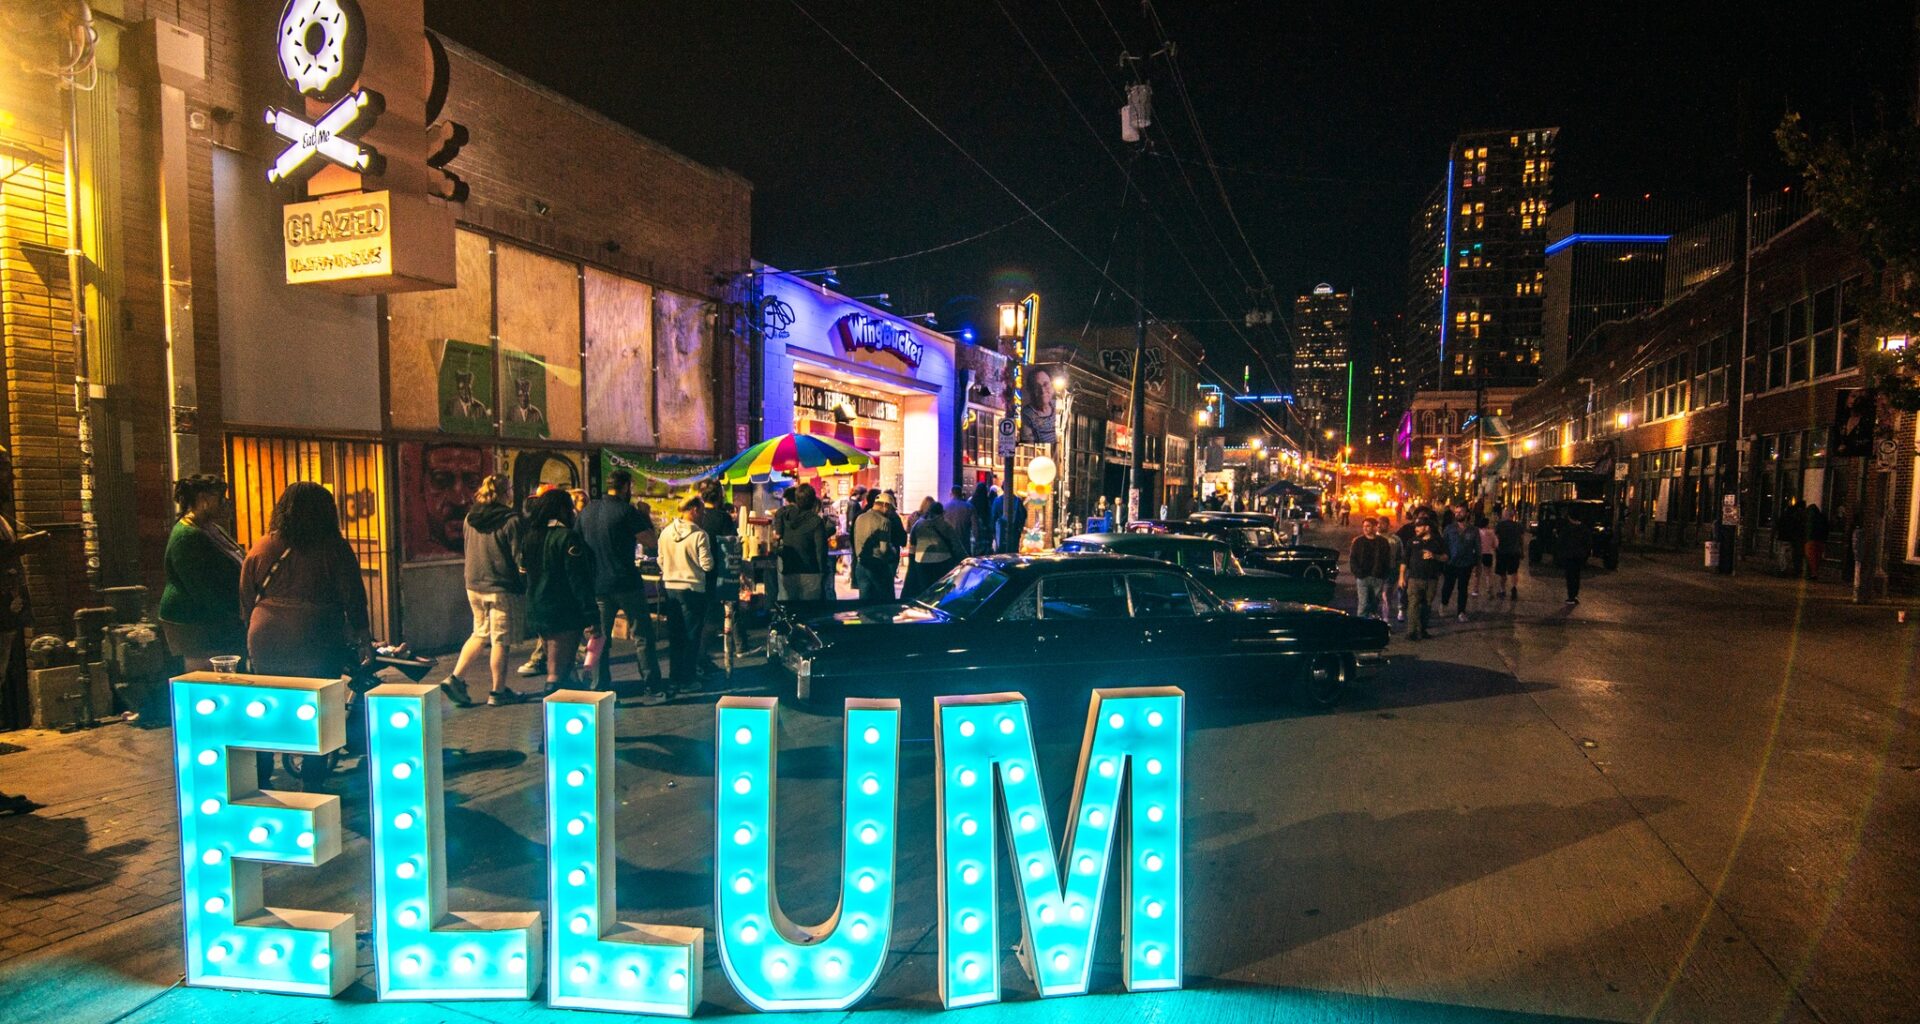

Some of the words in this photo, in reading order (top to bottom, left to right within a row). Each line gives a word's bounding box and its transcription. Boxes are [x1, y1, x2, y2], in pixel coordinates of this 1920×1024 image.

[318, 130, 330, 144] Me
[287, 204, 386, 247] GLAZED
[170, 672, 1186, 1017] ELLUM
